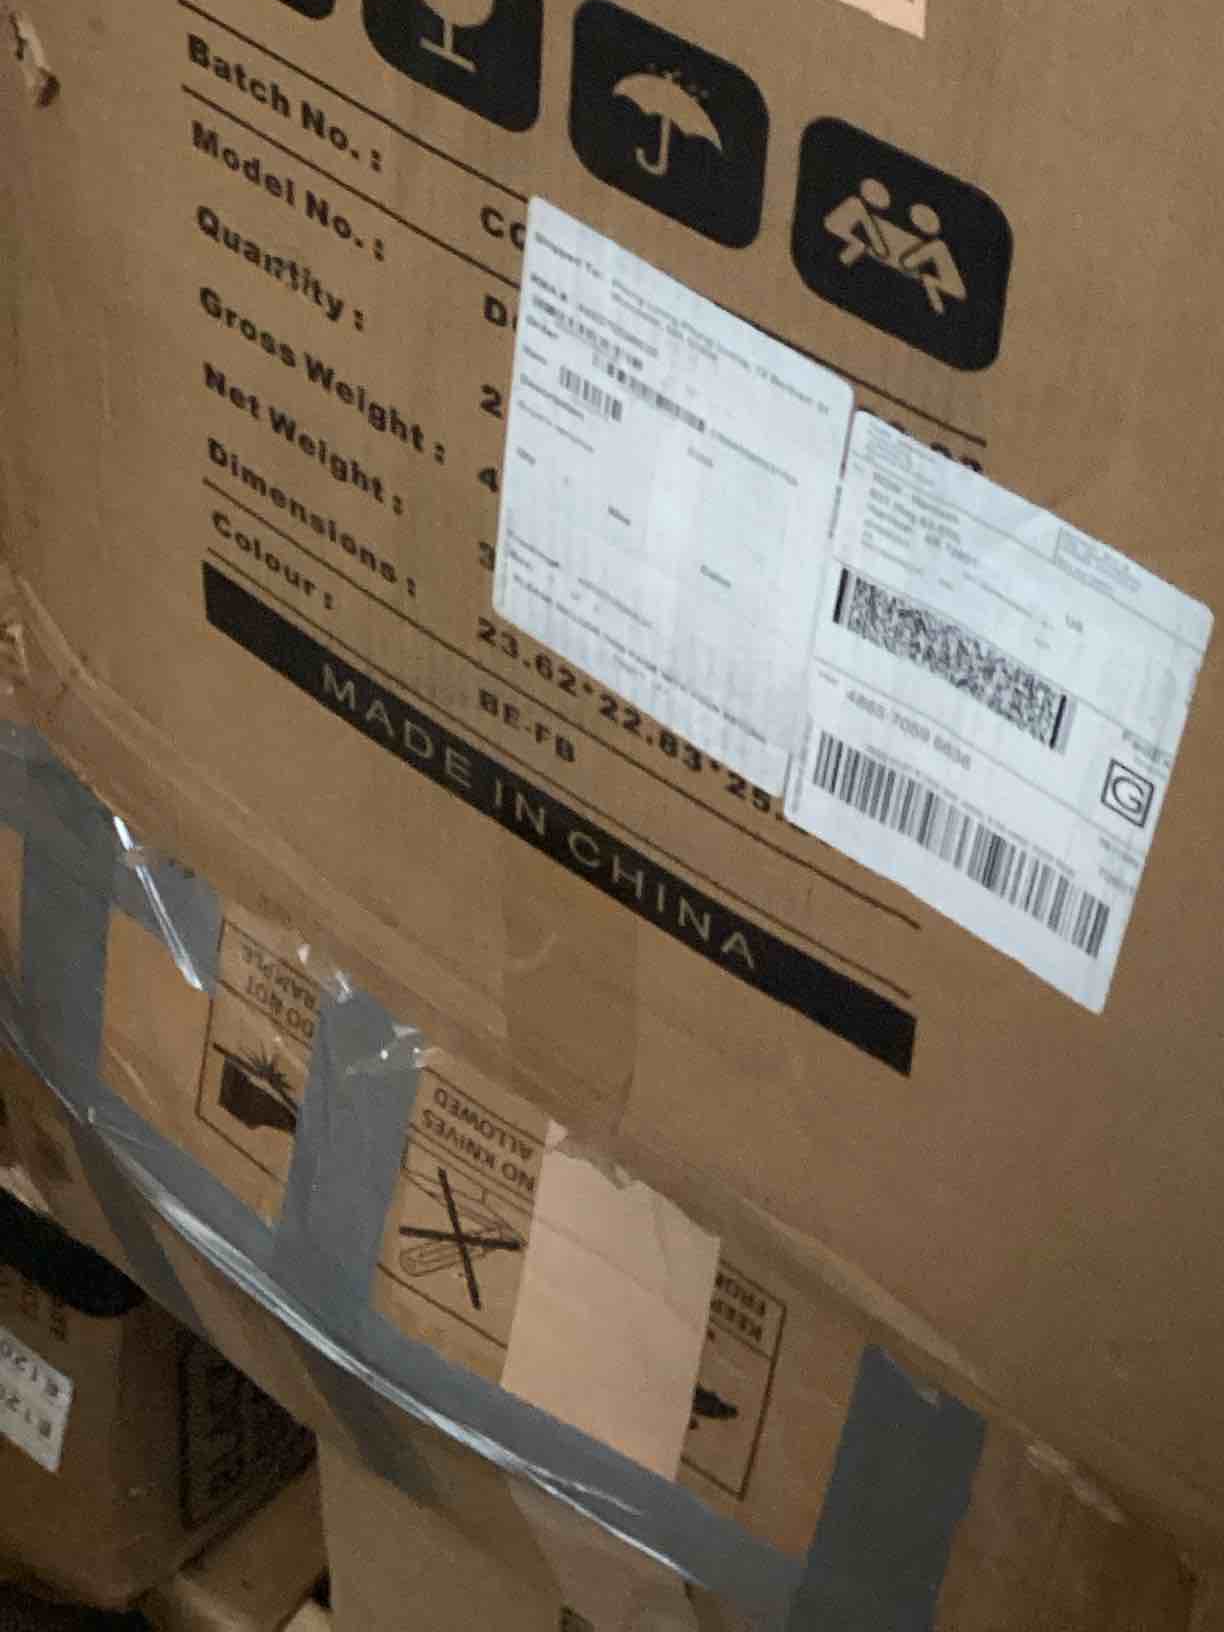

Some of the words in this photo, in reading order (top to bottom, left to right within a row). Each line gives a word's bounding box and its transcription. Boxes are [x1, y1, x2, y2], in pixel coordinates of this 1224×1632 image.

[188, 32, 291, 118] Batch
[192, 120, 295, 207] Model
[200, 287, 297, 369] Gross
[203, 361, 261, 420] Net
[321, 662, 474, 790] MADE
[494, 775, 546, 837] IN
[567, 830, 756, 970] CHINA
[422, 1108, 497, 1169] KNIVES
[433, 1087, 535, 1161] ALLOWED
